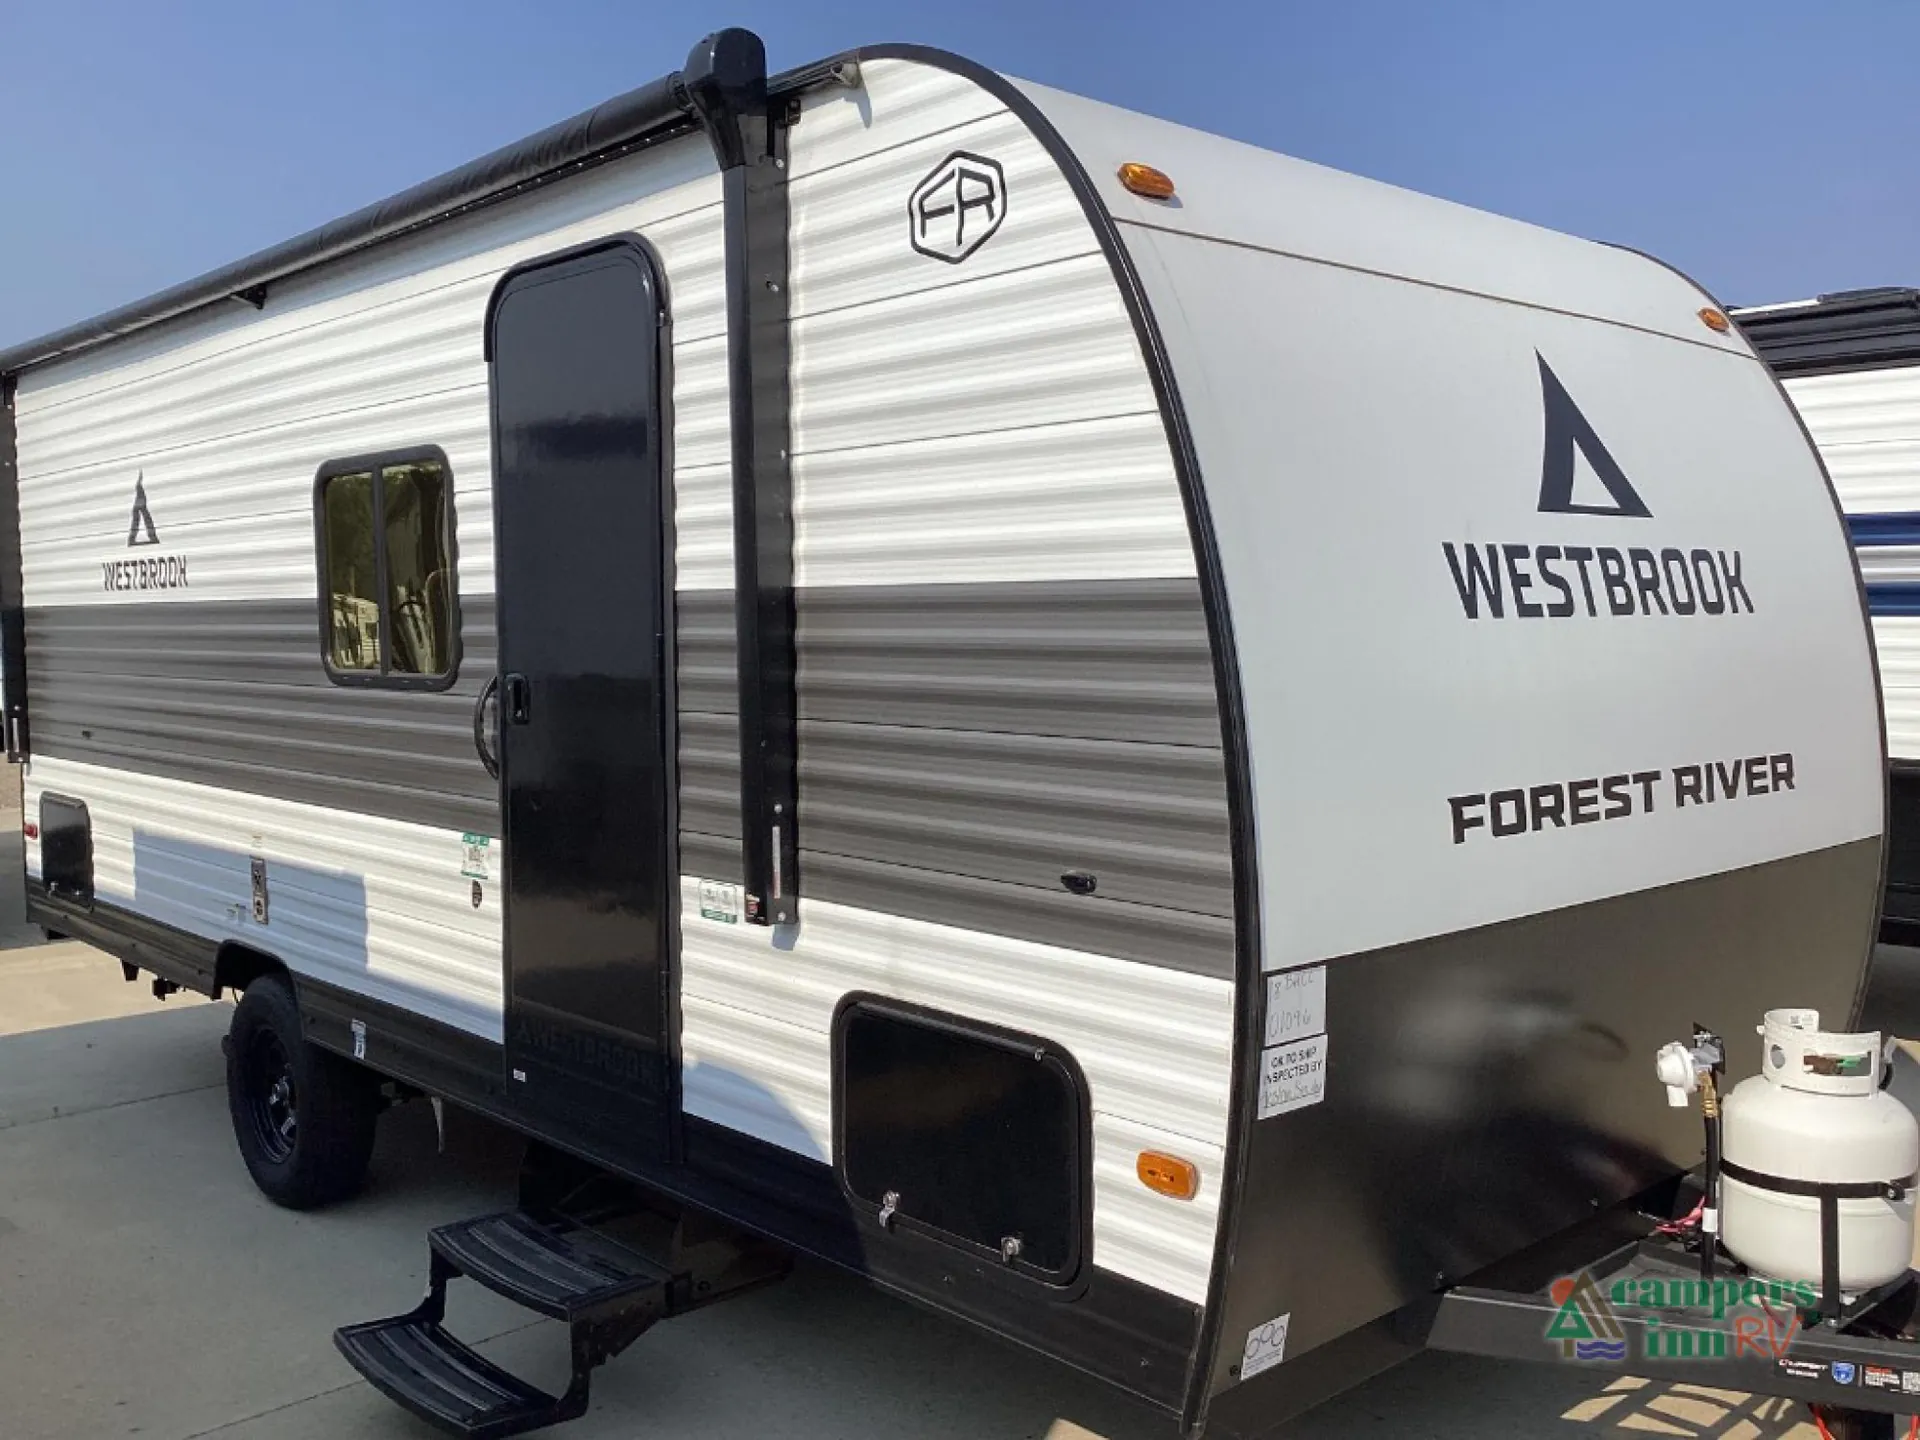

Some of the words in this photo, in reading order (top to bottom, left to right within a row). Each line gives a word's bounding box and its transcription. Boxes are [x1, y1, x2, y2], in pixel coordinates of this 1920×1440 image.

[917, 165, 996, 248] FR
[102, 554, 188, 591] WESTBROOK
[1441, 541, 1755, 619] WESTBROOK
[1447, 769, 1662, 845] FOREST
[1671, 752, 1796, 808] RIVER
[1264, 1062, 1309, 1084] INSPECTED
[1311, 1059, 1323, 1073] BY
[1286, 1051, 1297, 1064] TO
